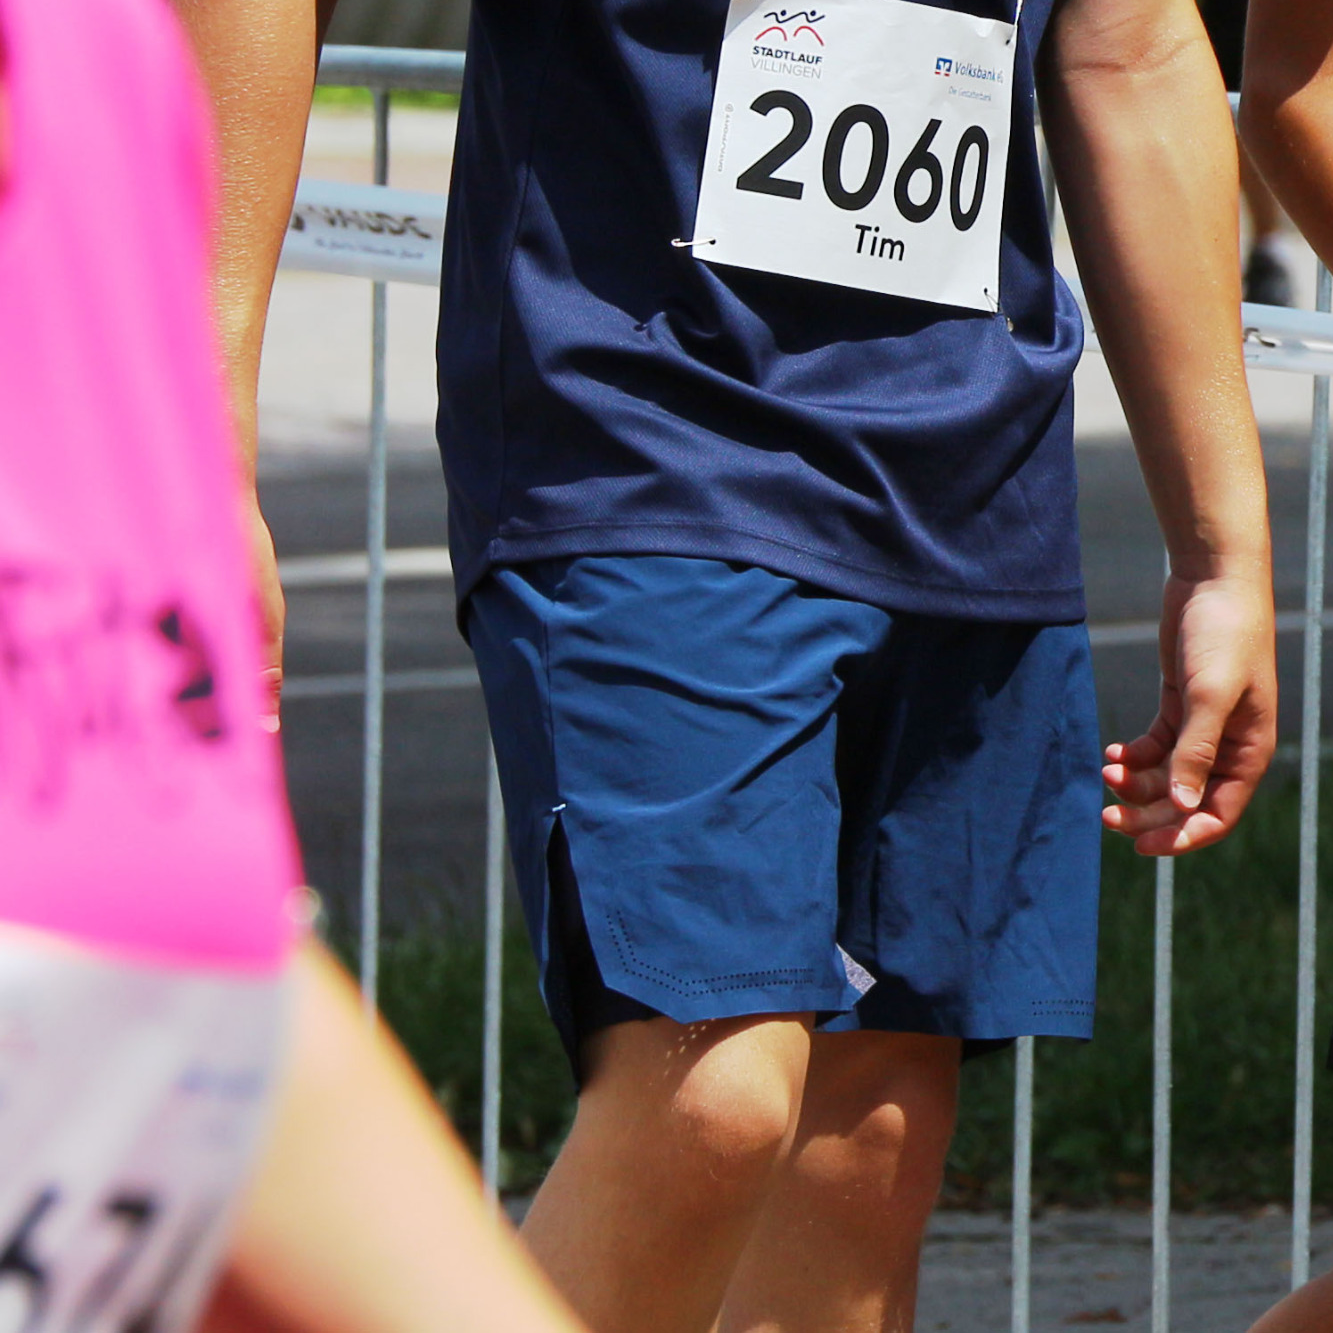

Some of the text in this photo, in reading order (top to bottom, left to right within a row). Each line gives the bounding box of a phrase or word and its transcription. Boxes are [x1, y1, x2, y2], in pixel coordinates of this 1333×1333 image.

[753, 45, 823, 65] STADTLAUF
[751, 57, 821, 79] VILLINGEN
[955, 61, 996, 81] Volksbank
[736, 89, 989, 232] 2060
[855, 223, 905, 261] Tim
